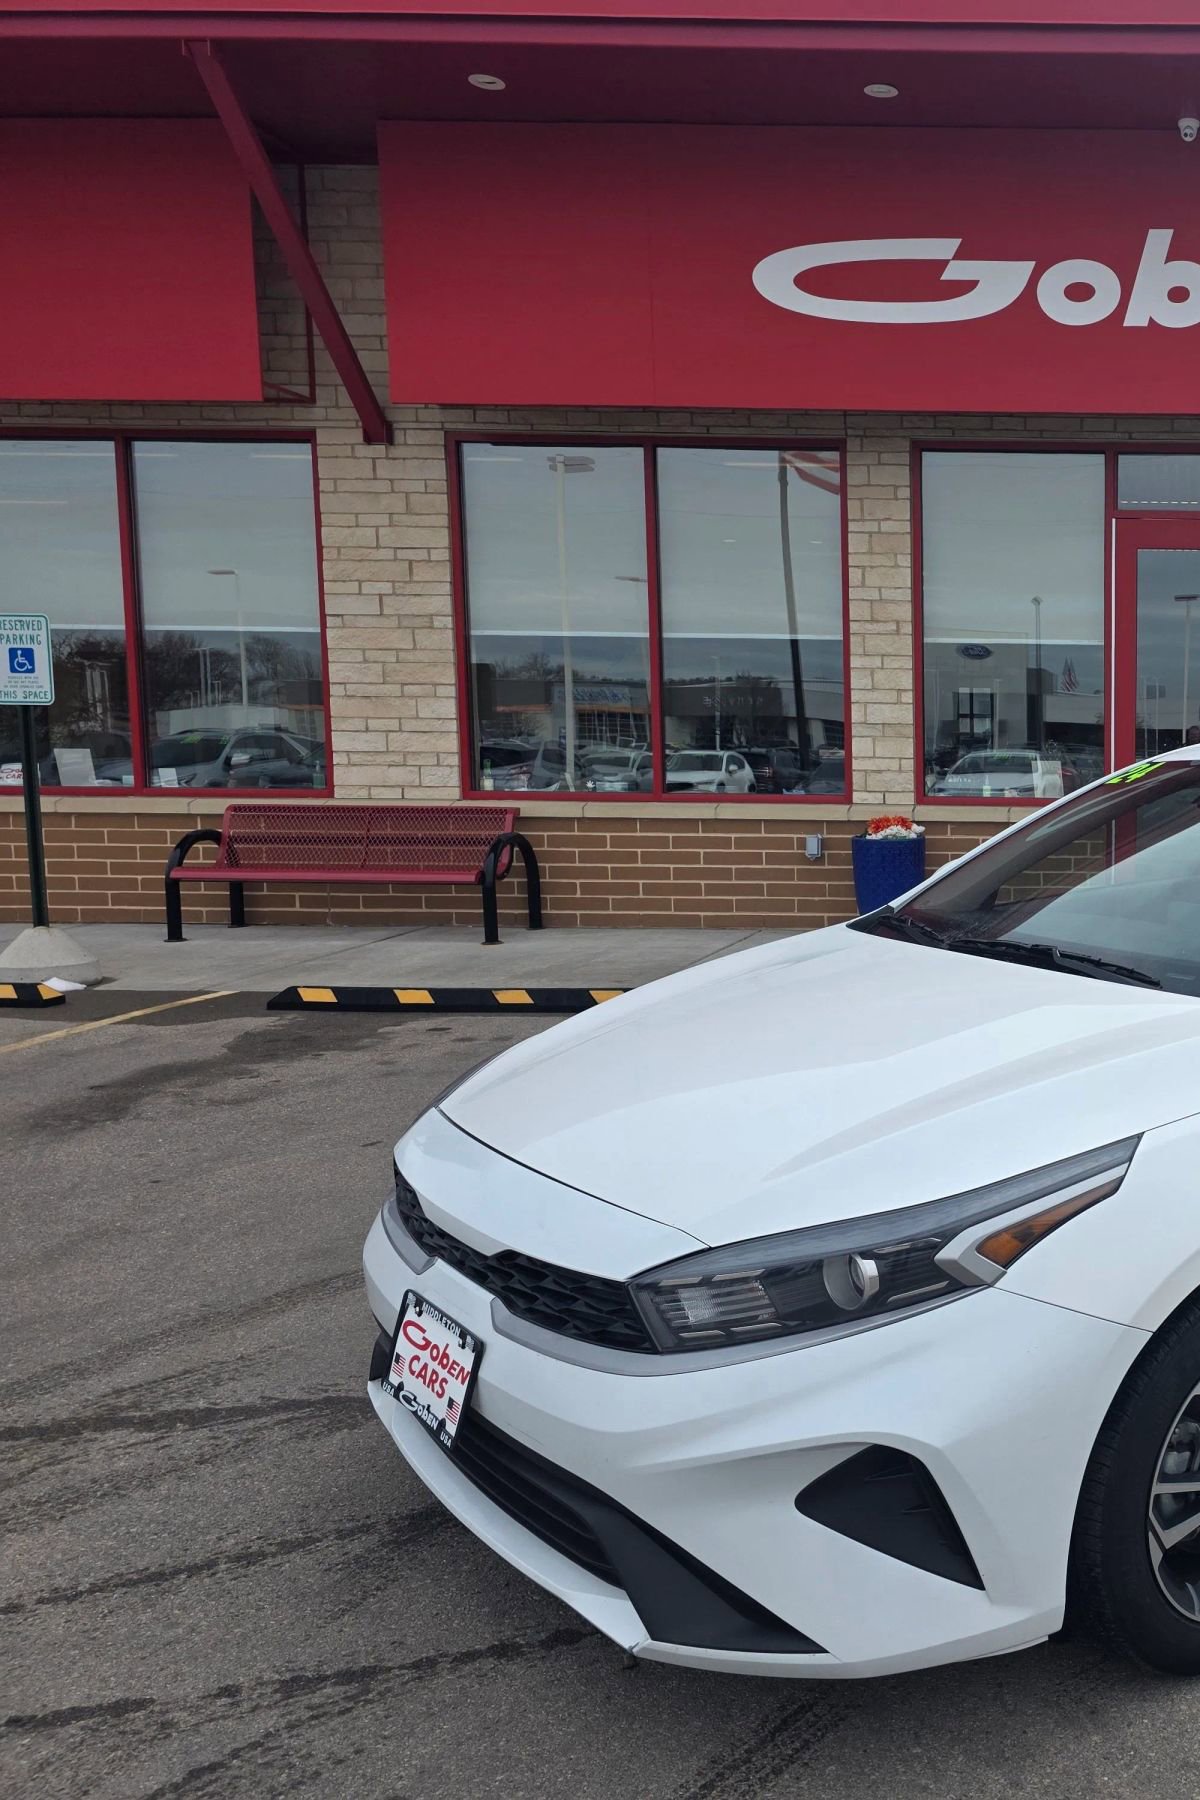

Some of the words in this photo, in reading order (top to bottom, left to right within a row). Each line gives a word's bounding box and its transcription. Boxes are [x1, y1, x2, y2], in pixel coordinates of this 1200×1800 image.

[0, 633, 42, 645] PARKING
[23, 690, 49, 700] SPACE
[421, 1302, 462, 1337] MIDDLETON
[408, 1355, 449, 1399] CARS
[382, 1382, 395, 1397] USA
[440, 1431, 452, 1449] USA
